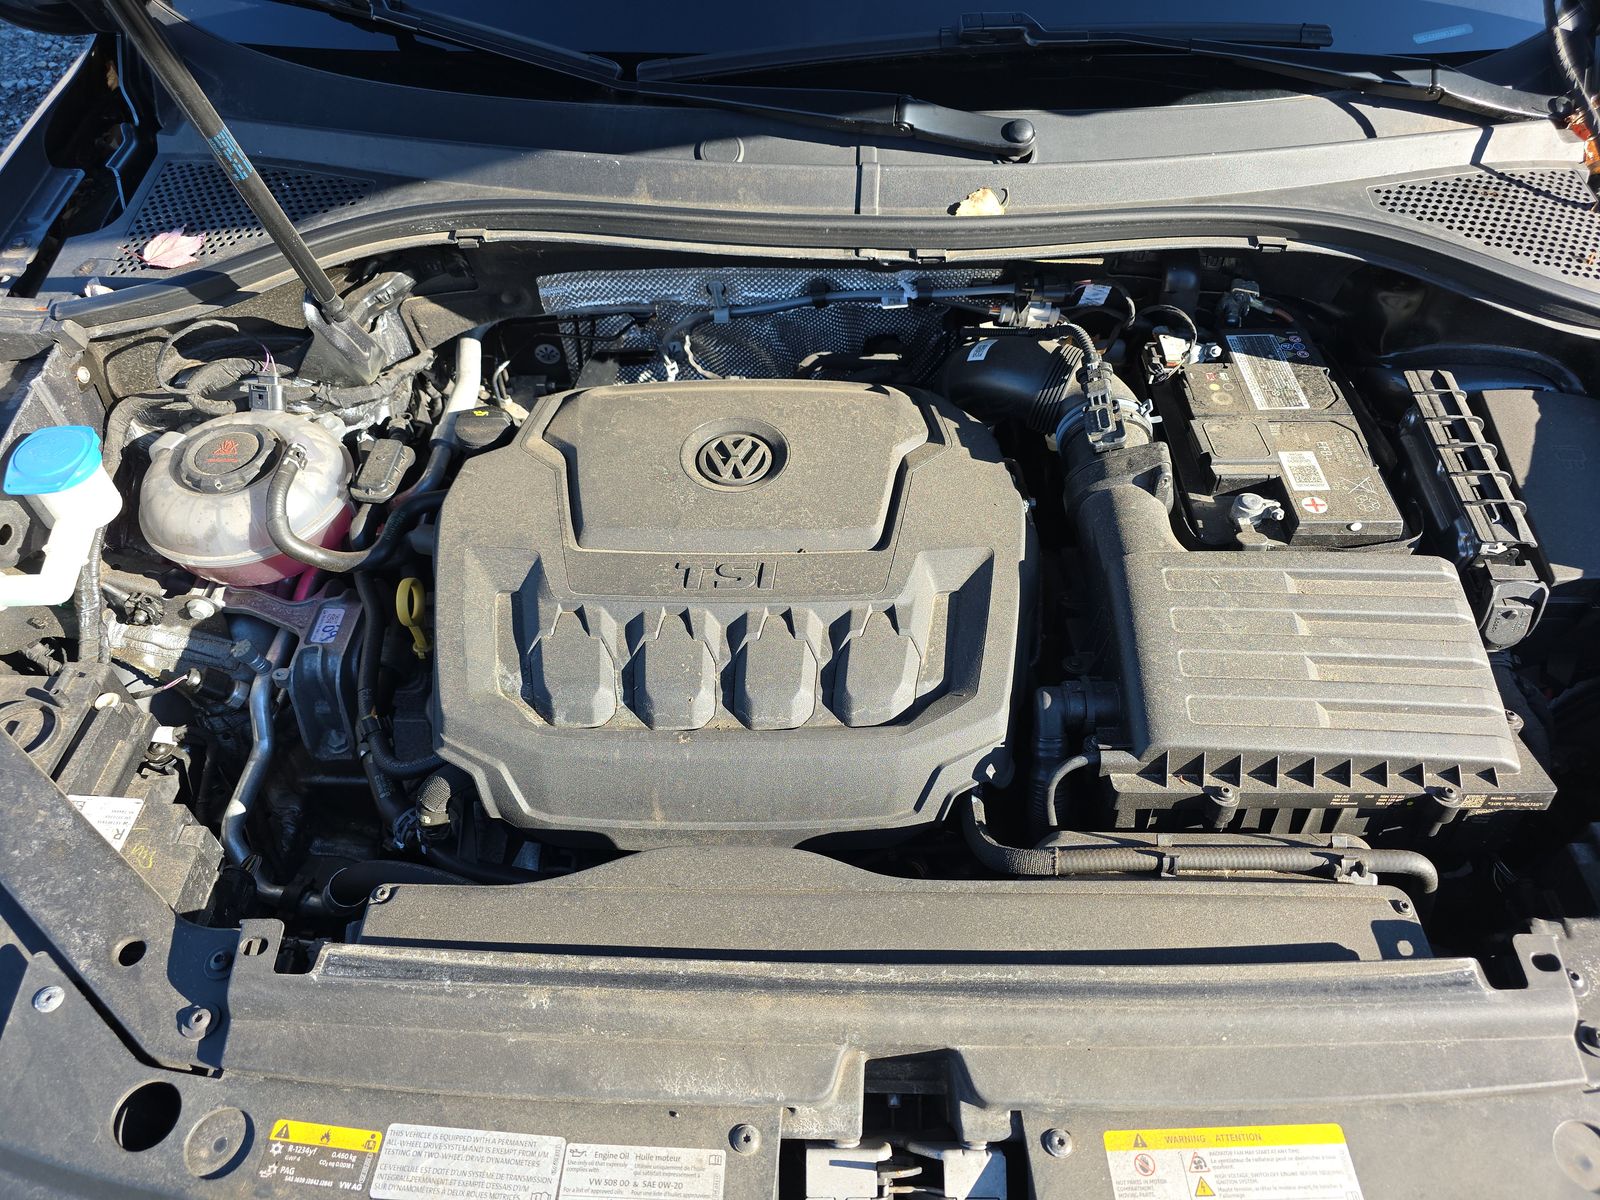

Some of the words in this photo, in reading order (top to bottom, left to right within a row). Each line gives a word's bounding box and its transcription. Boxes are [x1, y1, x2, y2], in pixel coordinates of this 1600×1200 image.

[674, 562, 778, 590] TSI
[405, 1130, 431, 1139] VEHICLE
[439, 1133, 472, 1142] EQUIPPED
[473, 1135, 490, 1143] WITH
[497, 1138, 537, 1147] PERMANENT
[1164, 1134, 1206, 1143] WARNING
[1215, 1132, 1262, 1142] ATTENTION
[287, 1144, 318, 1156] R-1234yf
[386, 1139, 422, 1148] ALL-WHEEL
[443, 1143, 467, 1151] SYSTEM
[491, 1148, 516, 1156] EXEMPT
[384, 1148, 410, 1157] TESTING
[424, 1152, 463, 1160] TWO-WHEEL
[465, 1155, 485, 1163] DRIVE
[594, 1151, 619, 1160] Engine
[619, 1152, 630, 1160] Oil
[280, 1166, 296, 1175] PAG
[495, 1172, 505, 1180] DE
[505, 1173, 552, 1184] TRANSMISSION
[589, 1178, 602, 1186] VW
[619, 1179, 630, 1187] 00
[642, 1180, 656, 1188] SAE
[658, 1181, 684, 1189] 0W-20
[339, 1181, 351, 1189] VW
[351, 1183, 362, 1191] AG
[466, 1190, 488, 1199] ROUES
